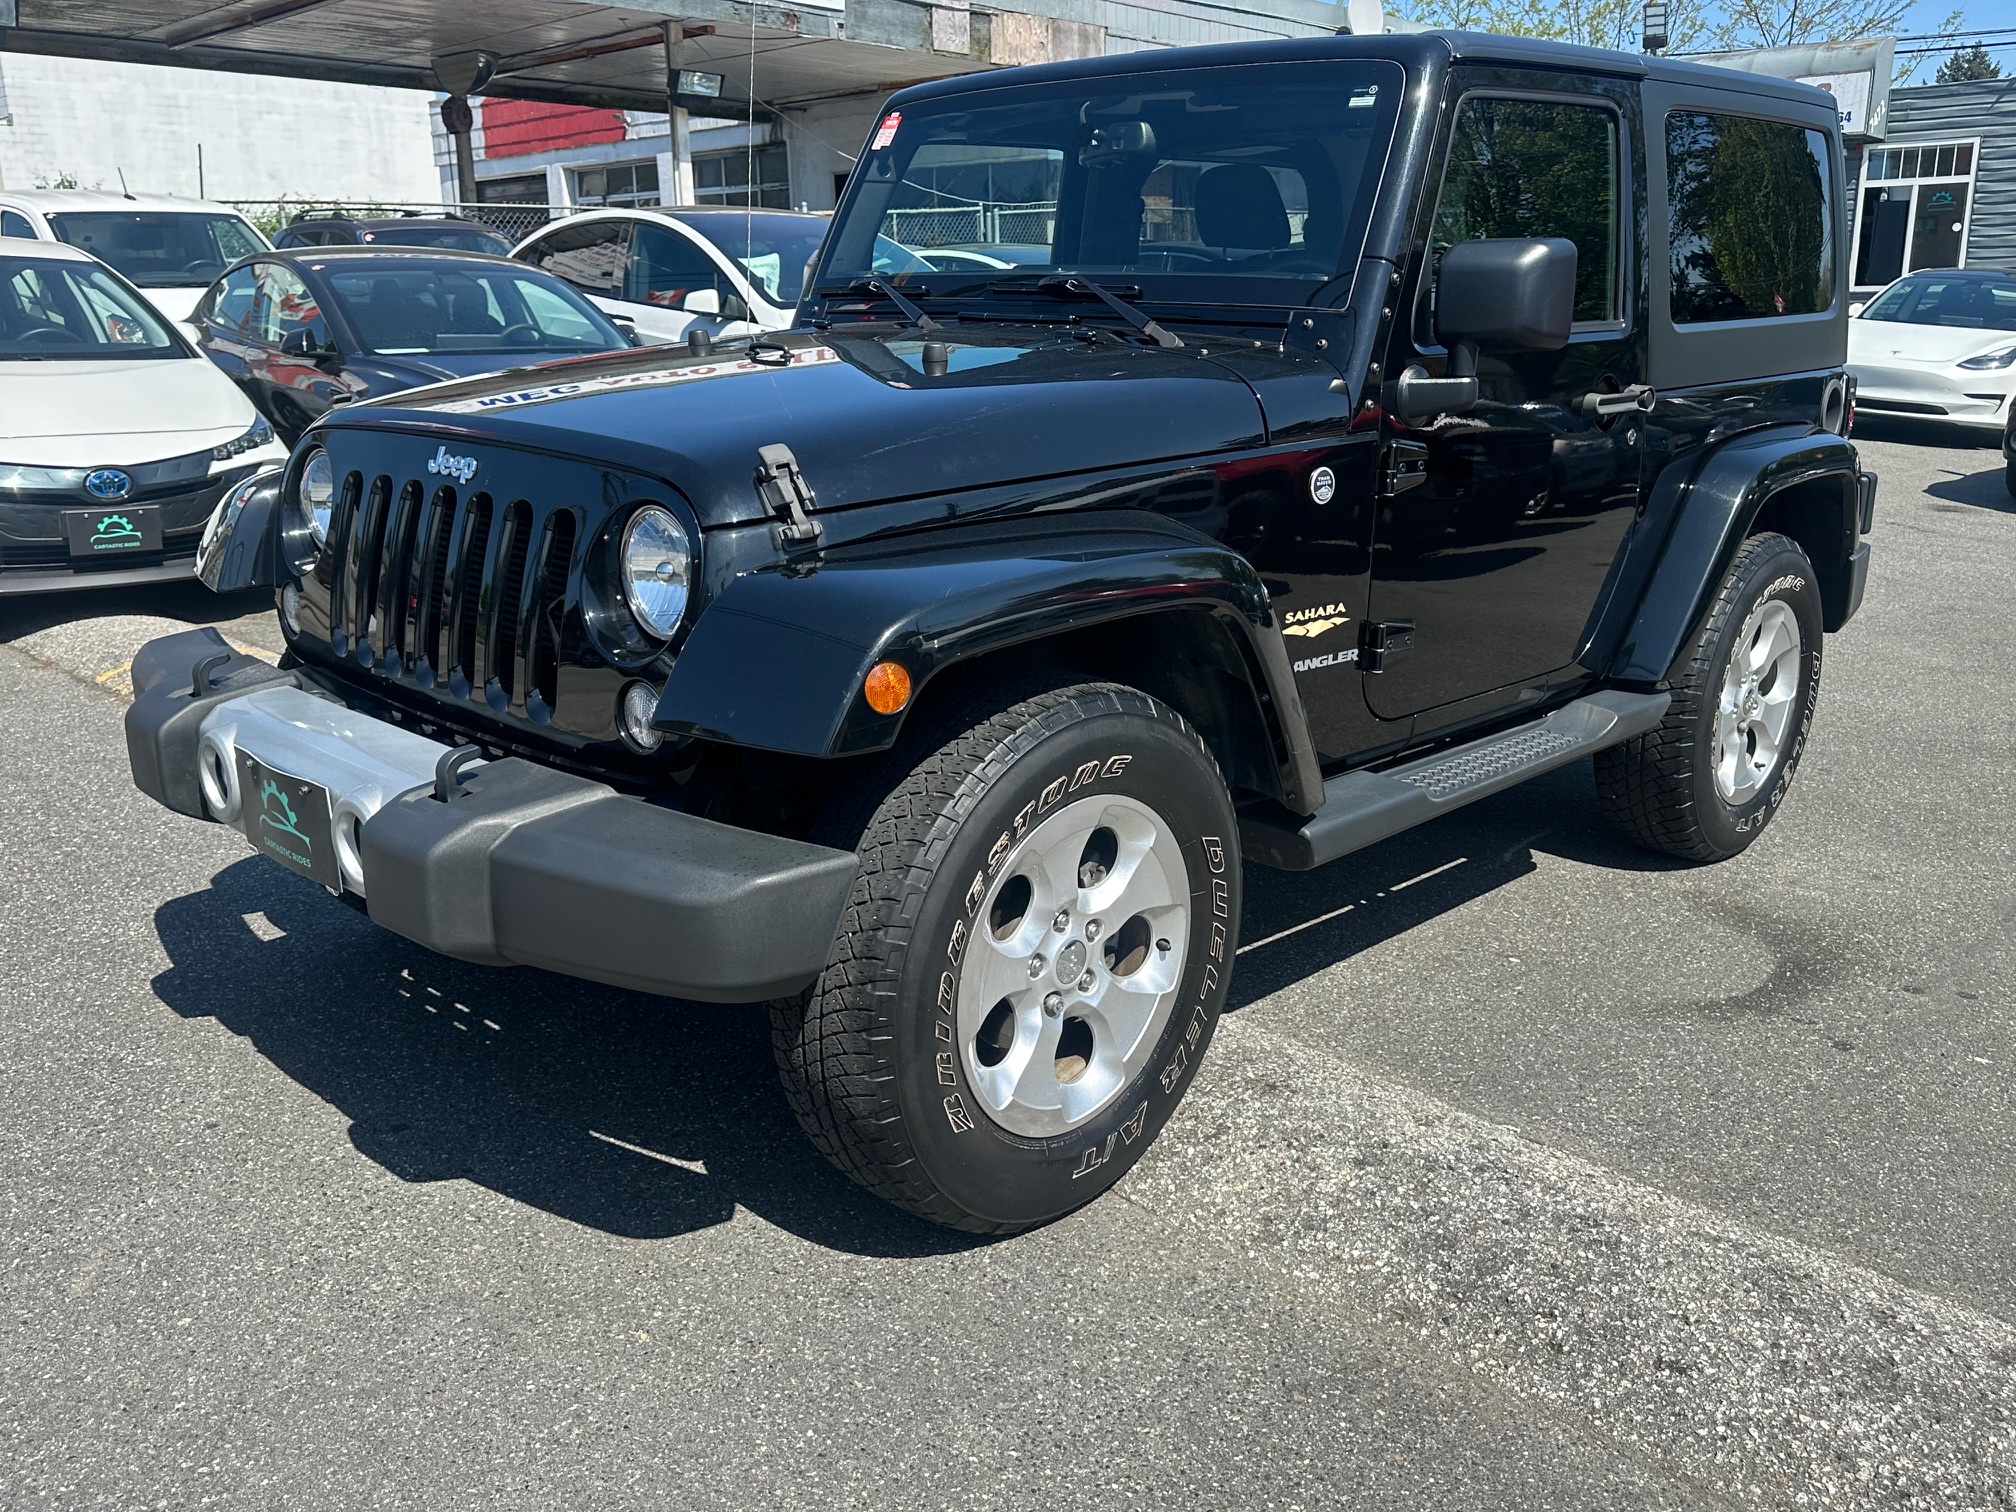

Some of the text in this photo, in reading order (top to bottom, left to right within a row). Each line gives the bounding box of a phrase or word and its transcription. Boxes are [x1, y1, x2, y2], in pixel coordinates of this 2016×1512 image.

[427, 445, 478, 485] Jeep
[93, 542, 124, 550] CARTASTIC
[1284, 602, 1347, 624] SAHARA
[1293, 648, 1359, 673] ANGLER
[263, 836, 312, 868] CARTASTIC RIDES
[935, 754, 1132, 1134] BRIDGESTONE
[1160, 835, 1228, 1094] DUELER
[1072, 1100, 1148, 1180] A/T
